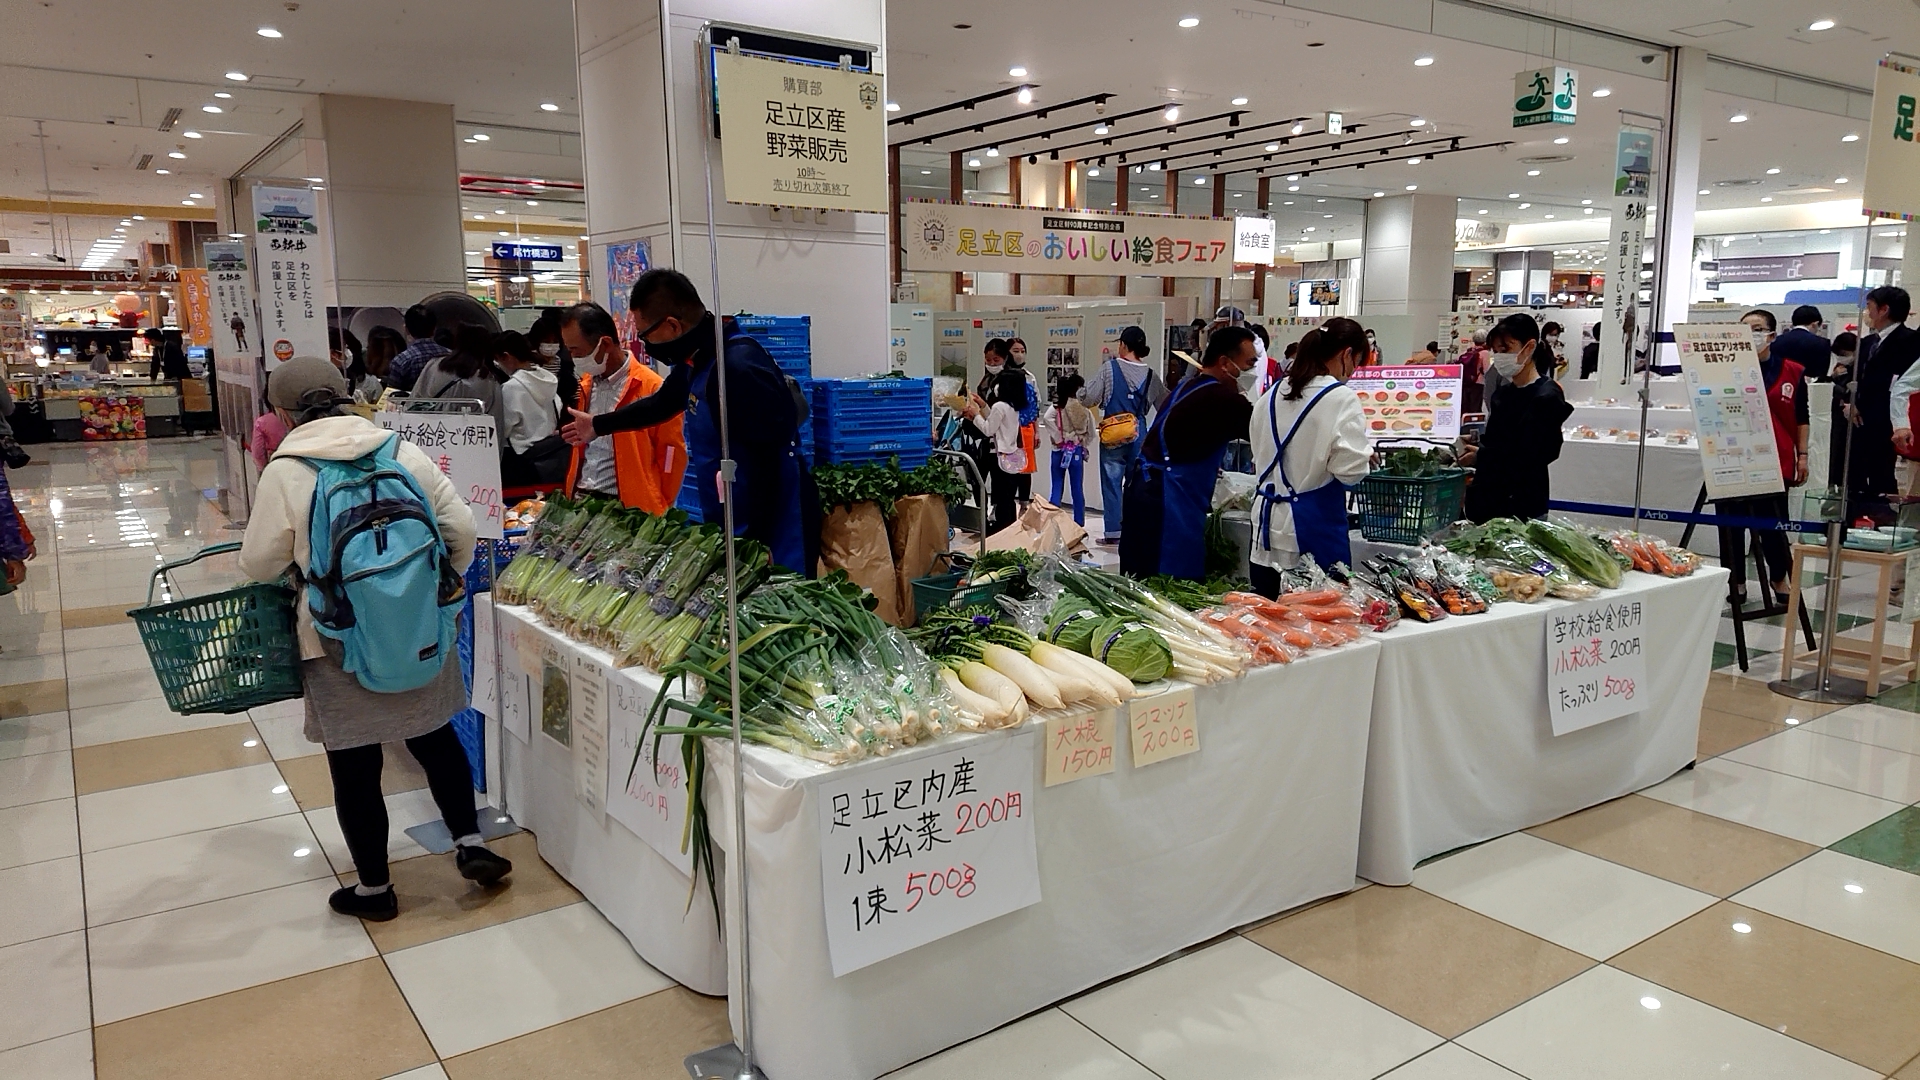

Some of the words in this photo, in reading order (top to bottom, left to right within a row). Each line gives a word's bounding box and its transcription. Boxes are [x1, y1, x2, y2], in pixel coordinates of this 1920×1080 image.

[783, 76, 823, 97] 購買部
[765, 101, 847, 133] 足立区産
[767, 132, 848, 164] 野菜販売
[773, 178, 851, 196] 売り切れ次第終了
[512, 247, 558, 259] 尾竹橋通り
[957, 228, 1227, 267] 足立区のおいしい給食フェア
[1240, 231, 1271, 249] 給食室
[285, 261, 298, 301] 足立区を
[299, 261, 315, 319] わたしたちは
[1614, 230, 1630, 325] 応援しています。
[271, 260, 287, 333] 応援しています。
[899, 291, 915, 301] 6-1
[1386, 369, 1431, 378] 学校給食パン
[1553, 601, 1642, 644] 学校給食使用
[1554, 637, 1607, 676] 小松菜
[1609, 637, 1641, 660] 200円
[1558, 680, 1599, 712] たっぷり
[1603, 675, 1636, 701] 500g
[1134, 701, 1188, 731] コマツナ
[1055, 718, 1104, 751] 大根
[1061, 745, 1113, 774] 150円
[830, 756, 978, 834] 足立区内産
[843, 810, 952, 875] 小松菜
[955, 792, 1022, 835] 200円
[905, 862, 977, 913] 500g
